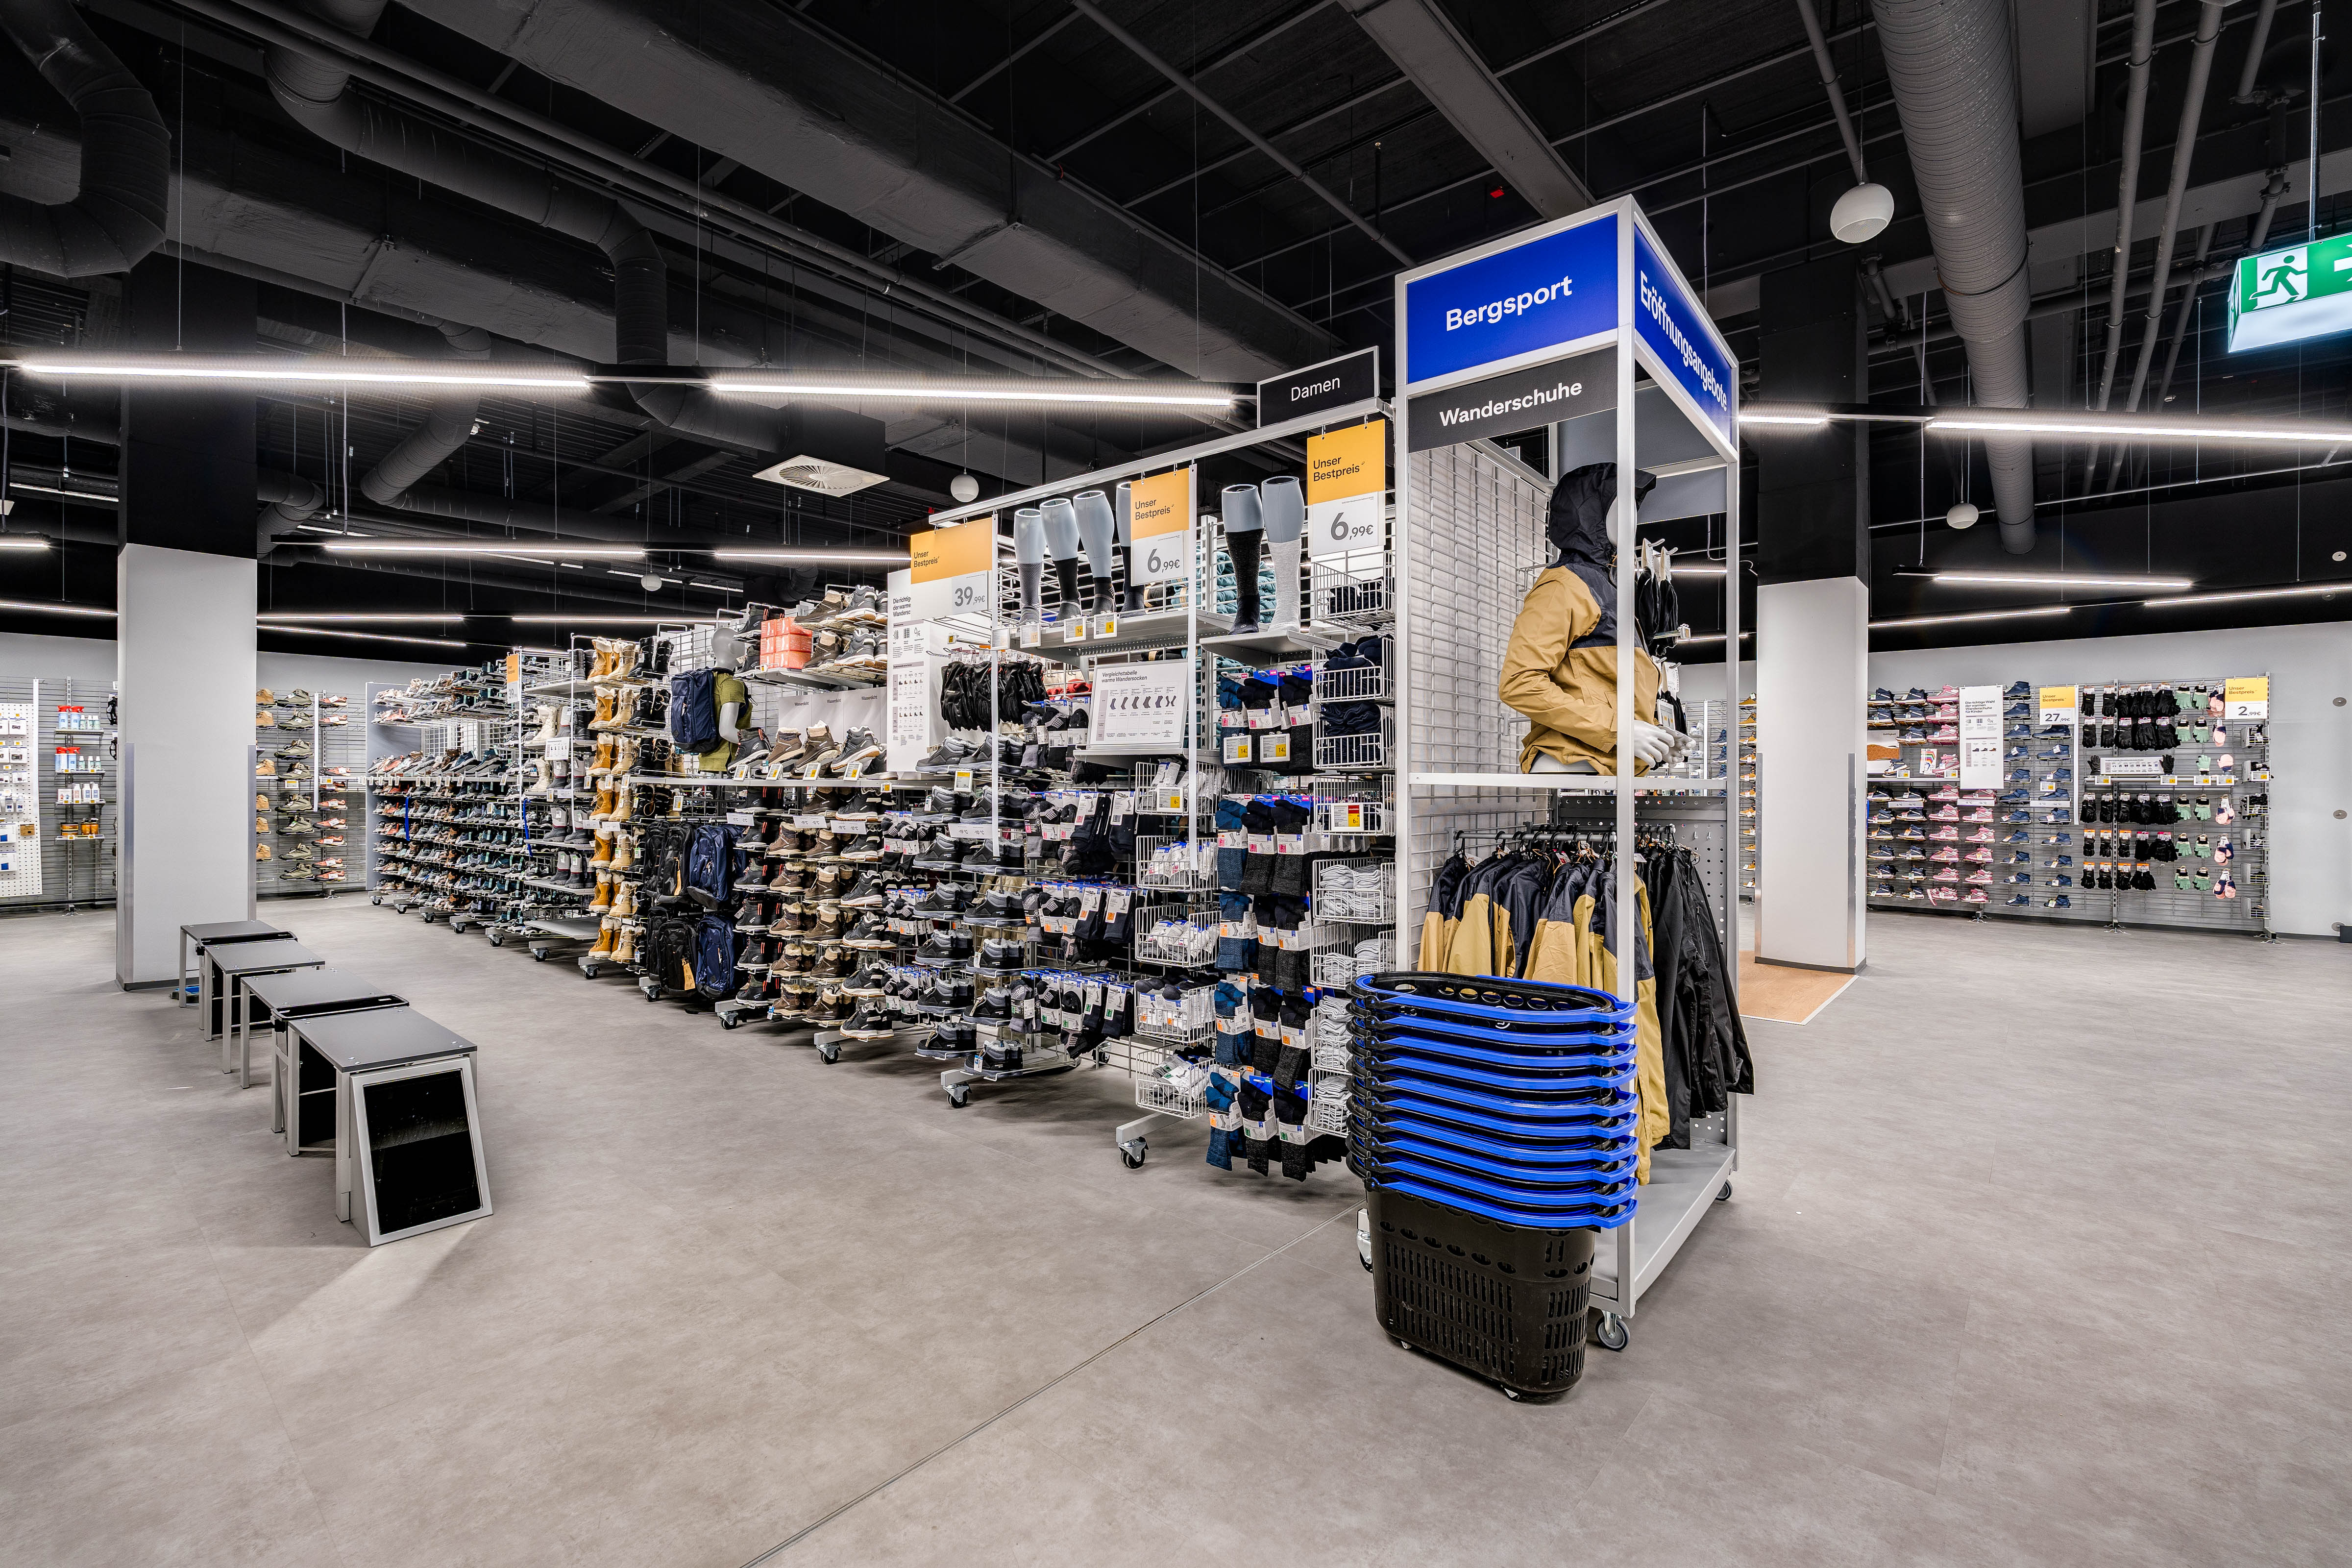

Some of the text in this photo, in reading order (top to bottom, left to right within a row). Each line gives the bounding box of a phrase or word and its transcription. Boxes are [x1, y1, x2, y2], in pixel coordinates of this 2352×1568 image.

[1446, 275, 1572, 331] Bergsport
[1641, 270, 1727, 413] Eröffnungsangebote
[1291, 377, 1340, 401] Damen
[1440, 382, 1582, 427] Wanderschuhe
[1313, 457, 1342, 469] Unser
[1313, 464, 1360, 482] Bestpreis
[1135, 499, 1157, 510] Unser
[1135, 505, 1171, 520] Bestpreis
[1331, 512, 1373, 540] 6,99€
[914, 551, 929, 559] Unser
[914, 557, 938, 567] Bestpreis
[1147, 548, 1180, 573] 6,99€
[955, 586, 985, 607] 39,99€
[2045, 713, 2070, 722] 27,99€
[2238, 706, 2261, 716] 2,99€
